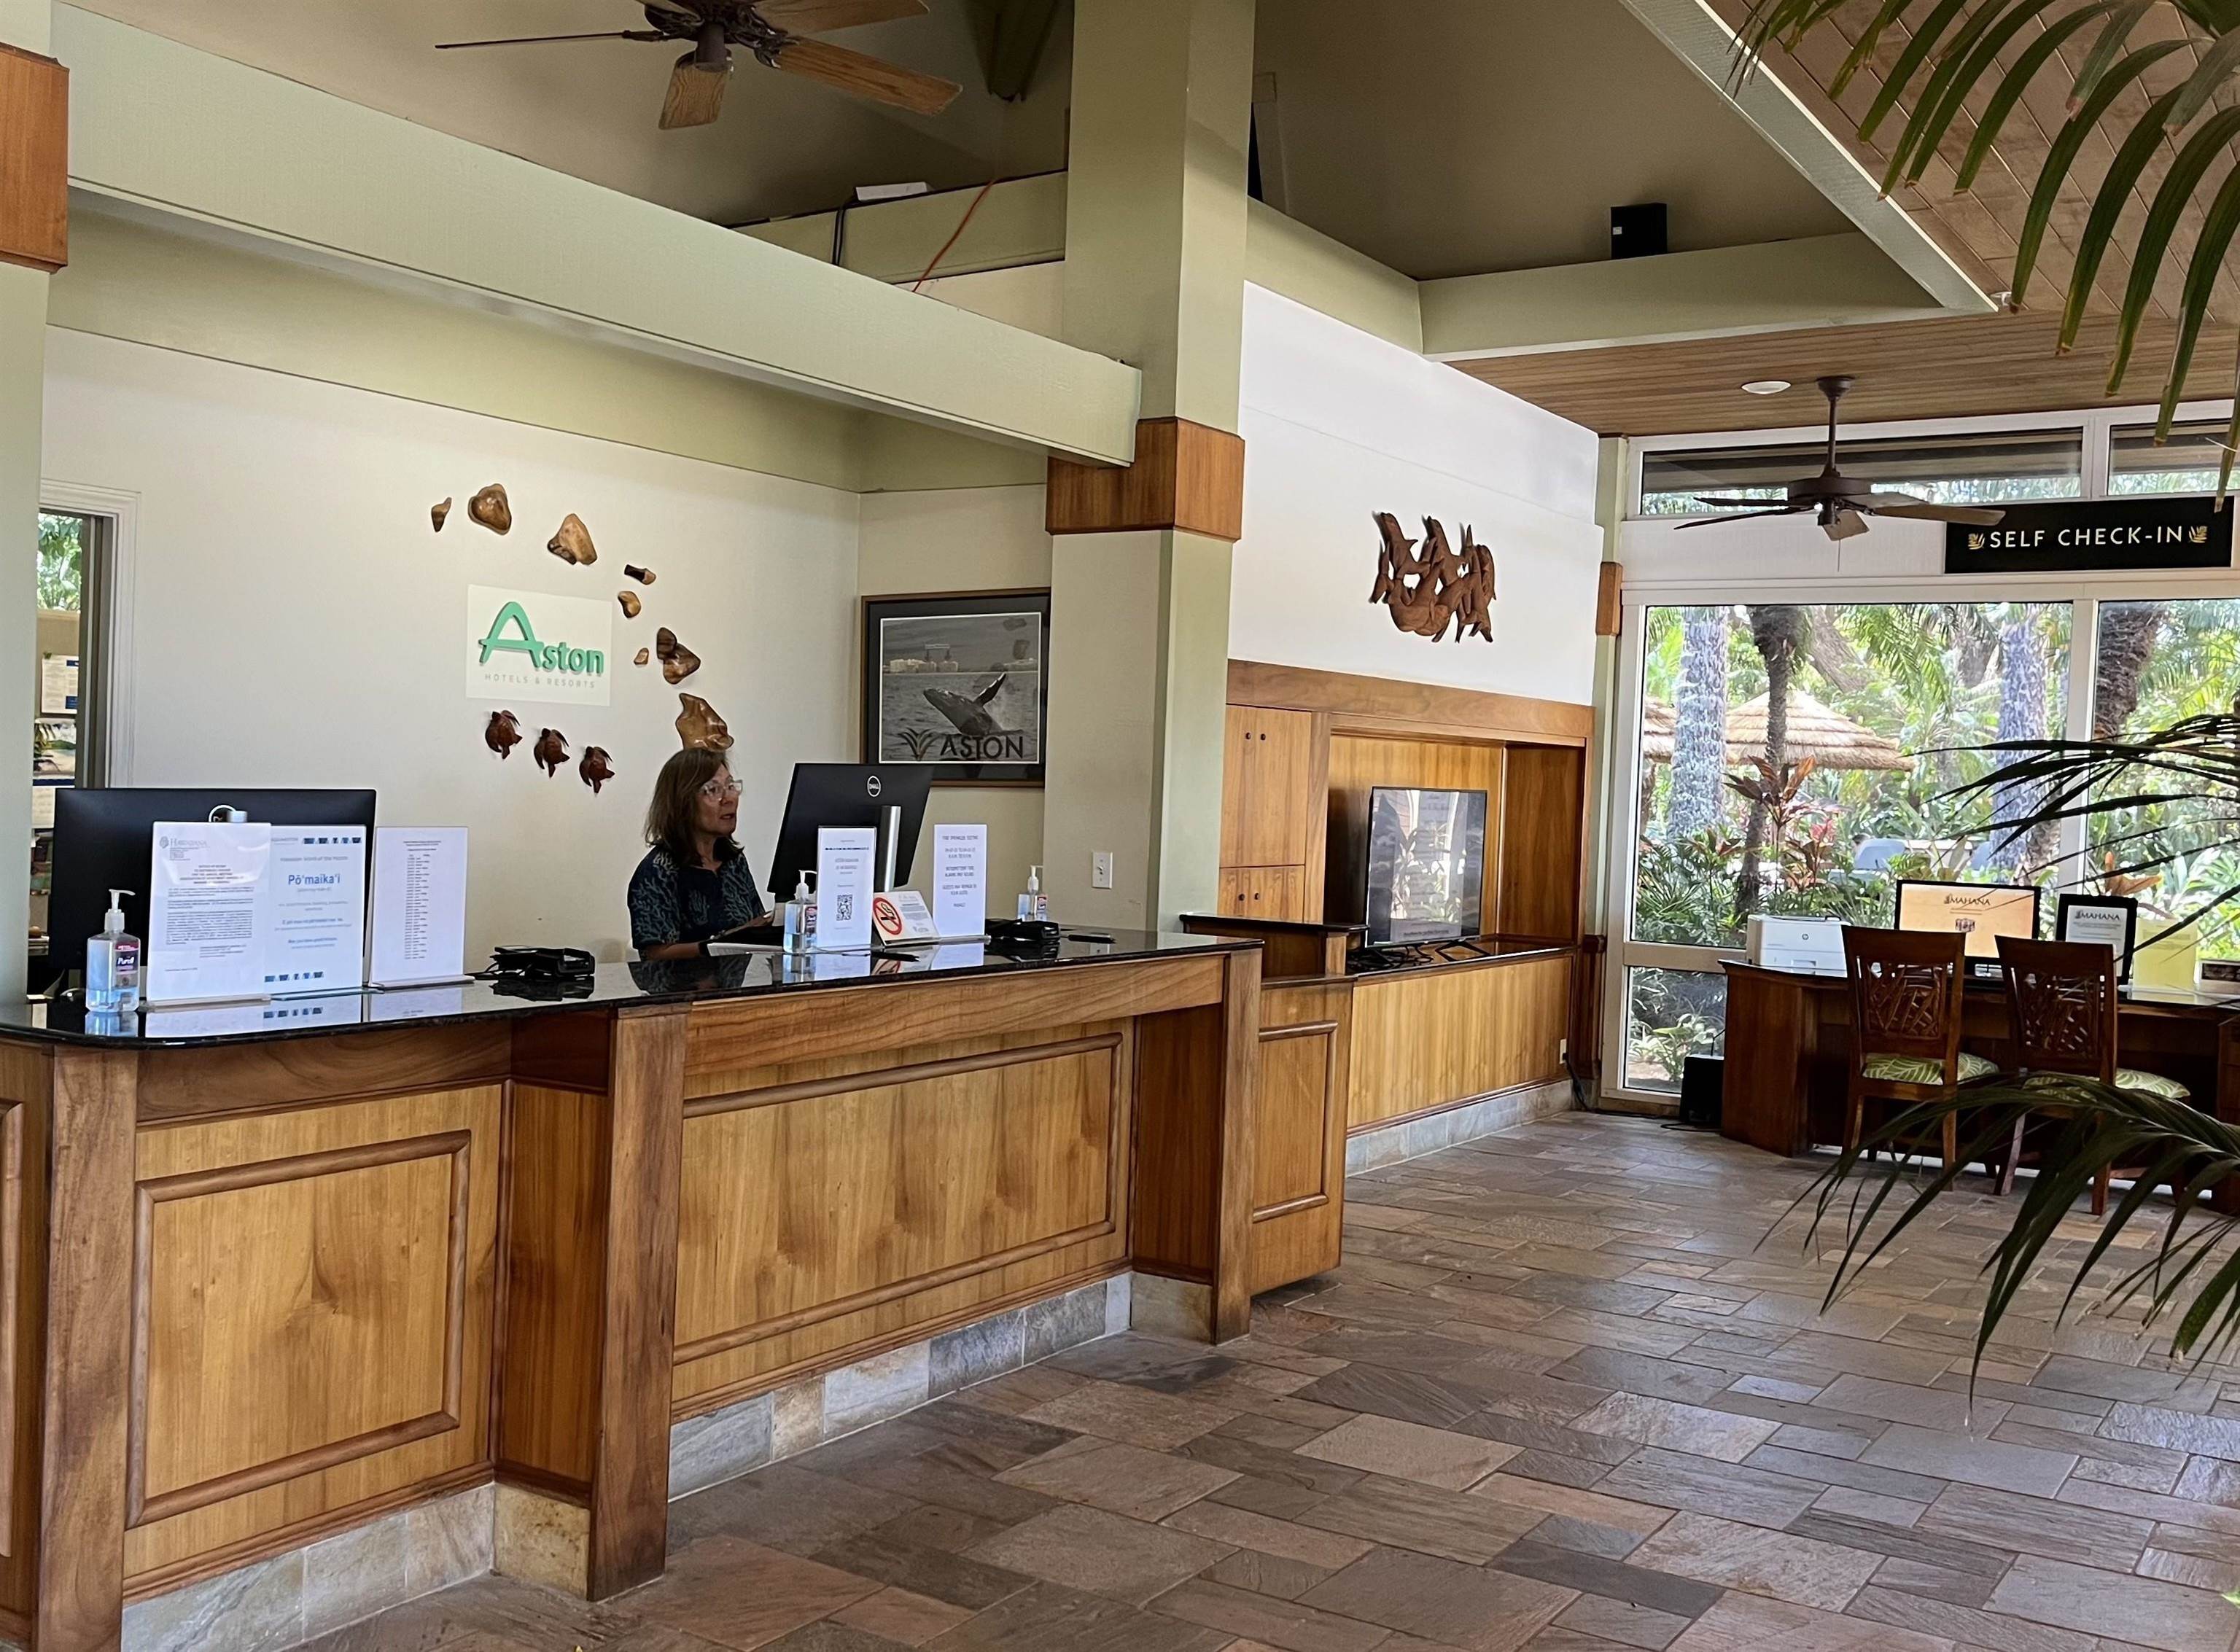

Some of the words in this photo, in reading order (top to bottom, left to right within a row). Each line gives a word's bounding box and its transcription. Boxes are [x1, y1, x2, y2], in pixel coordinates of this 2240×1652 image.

[1989, 530, 2045, 548] SELF
[2058, 525, 2182, 547] CHECK-IN
[478, 601, 604, 675] Aston
[484, 674, 529, 684] HOTELS
[547, 678, 595, 688] RESORTS
[940, 736, 1024, 760] ASTON
[2081, 912, 2120, 921] MAHANA
